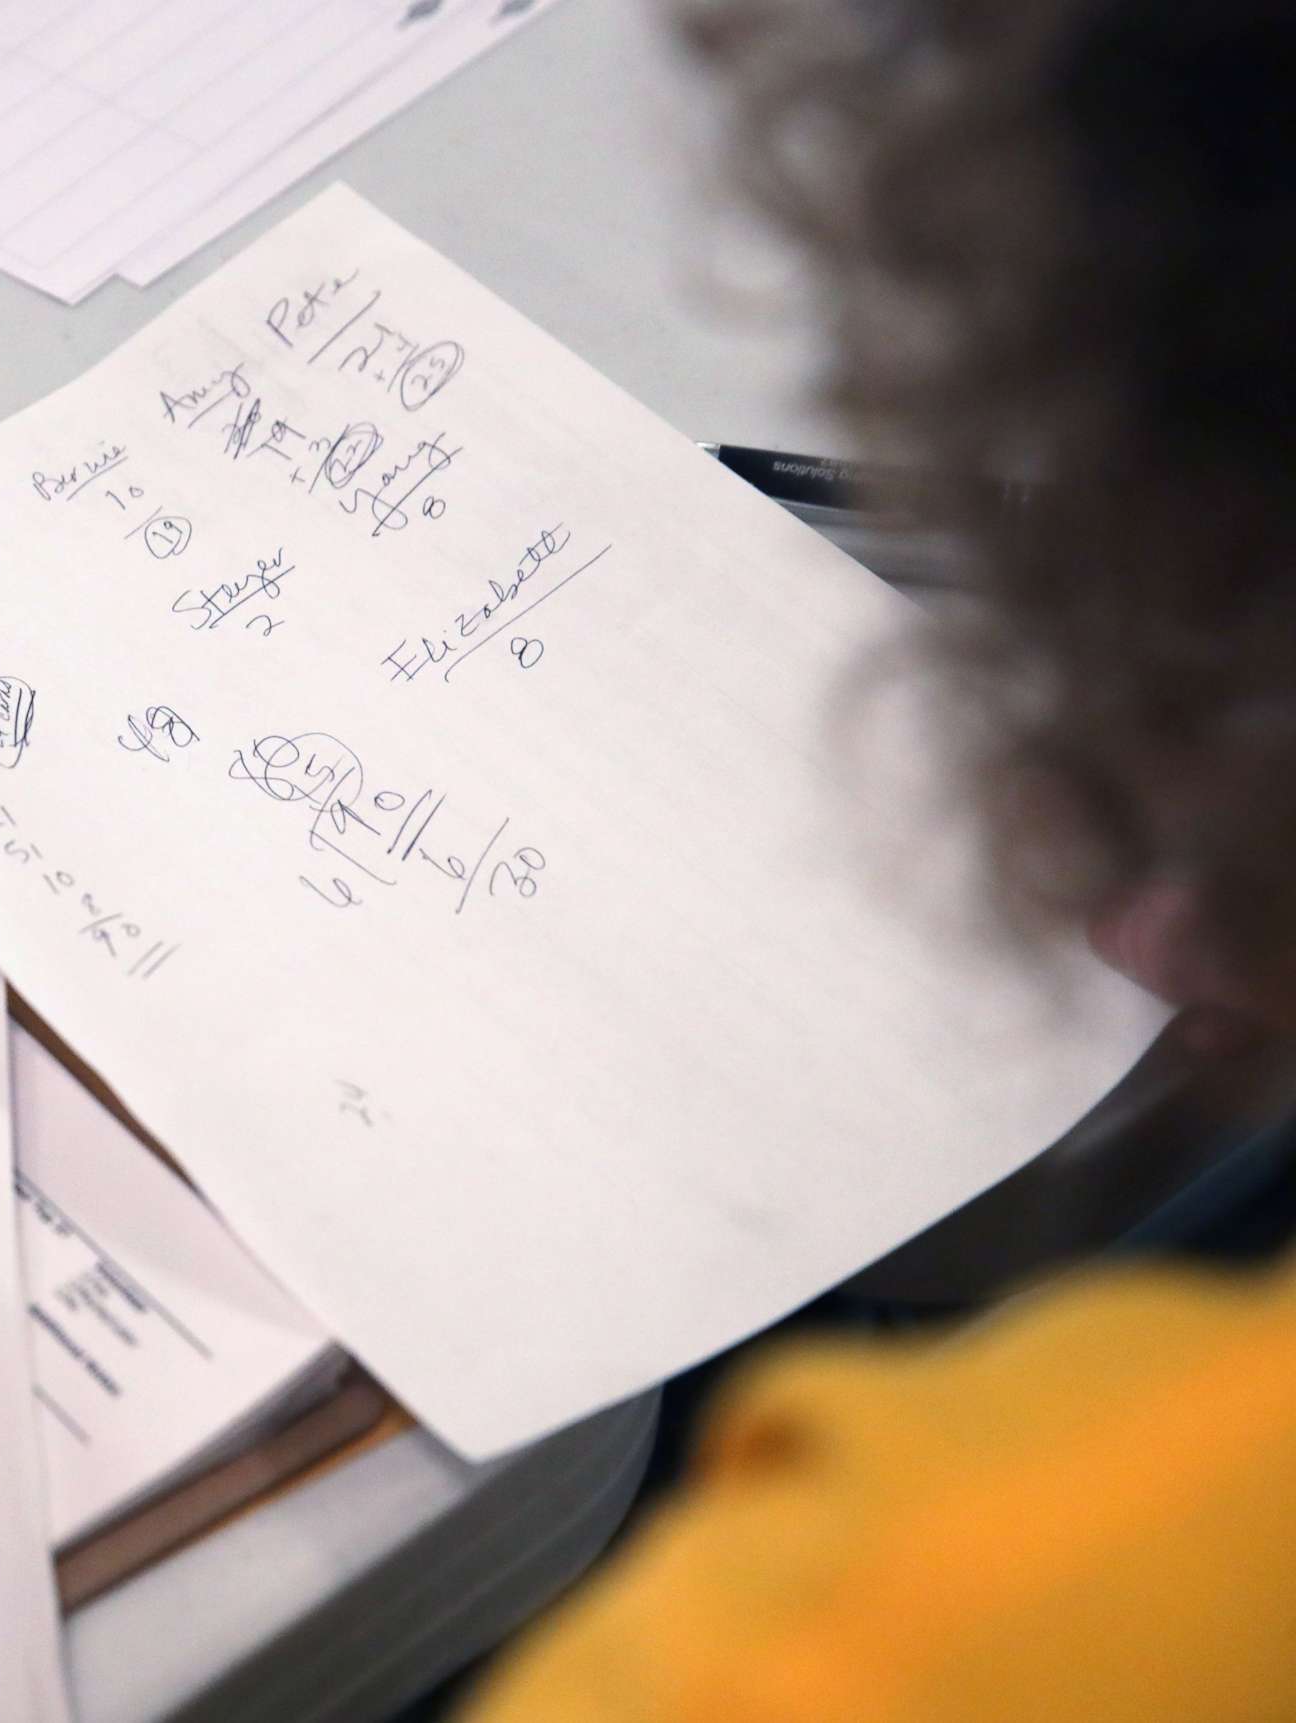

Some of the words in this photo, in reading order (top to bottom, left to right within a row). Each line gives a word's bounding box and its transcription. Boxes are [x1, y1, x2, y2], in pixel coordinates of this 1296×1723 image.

[266, 269, 360, 349] Pete
[159, 360, 252, 424] Amy
[31, 441, 128, 502] Bernie
[338, 431, 450, 531] Yang
[772, 461, 835, 481] Solutions
[105, 485, 145, 511] 10
[422, 495, 446, 520] 8
[150, 517, 180, 546] 19
[171, 546, 286, 631] Steyer
[245, 613, 287, 637] 2
[510, 636, 545, 670] 8
[42, 870, 76, 895] 10
